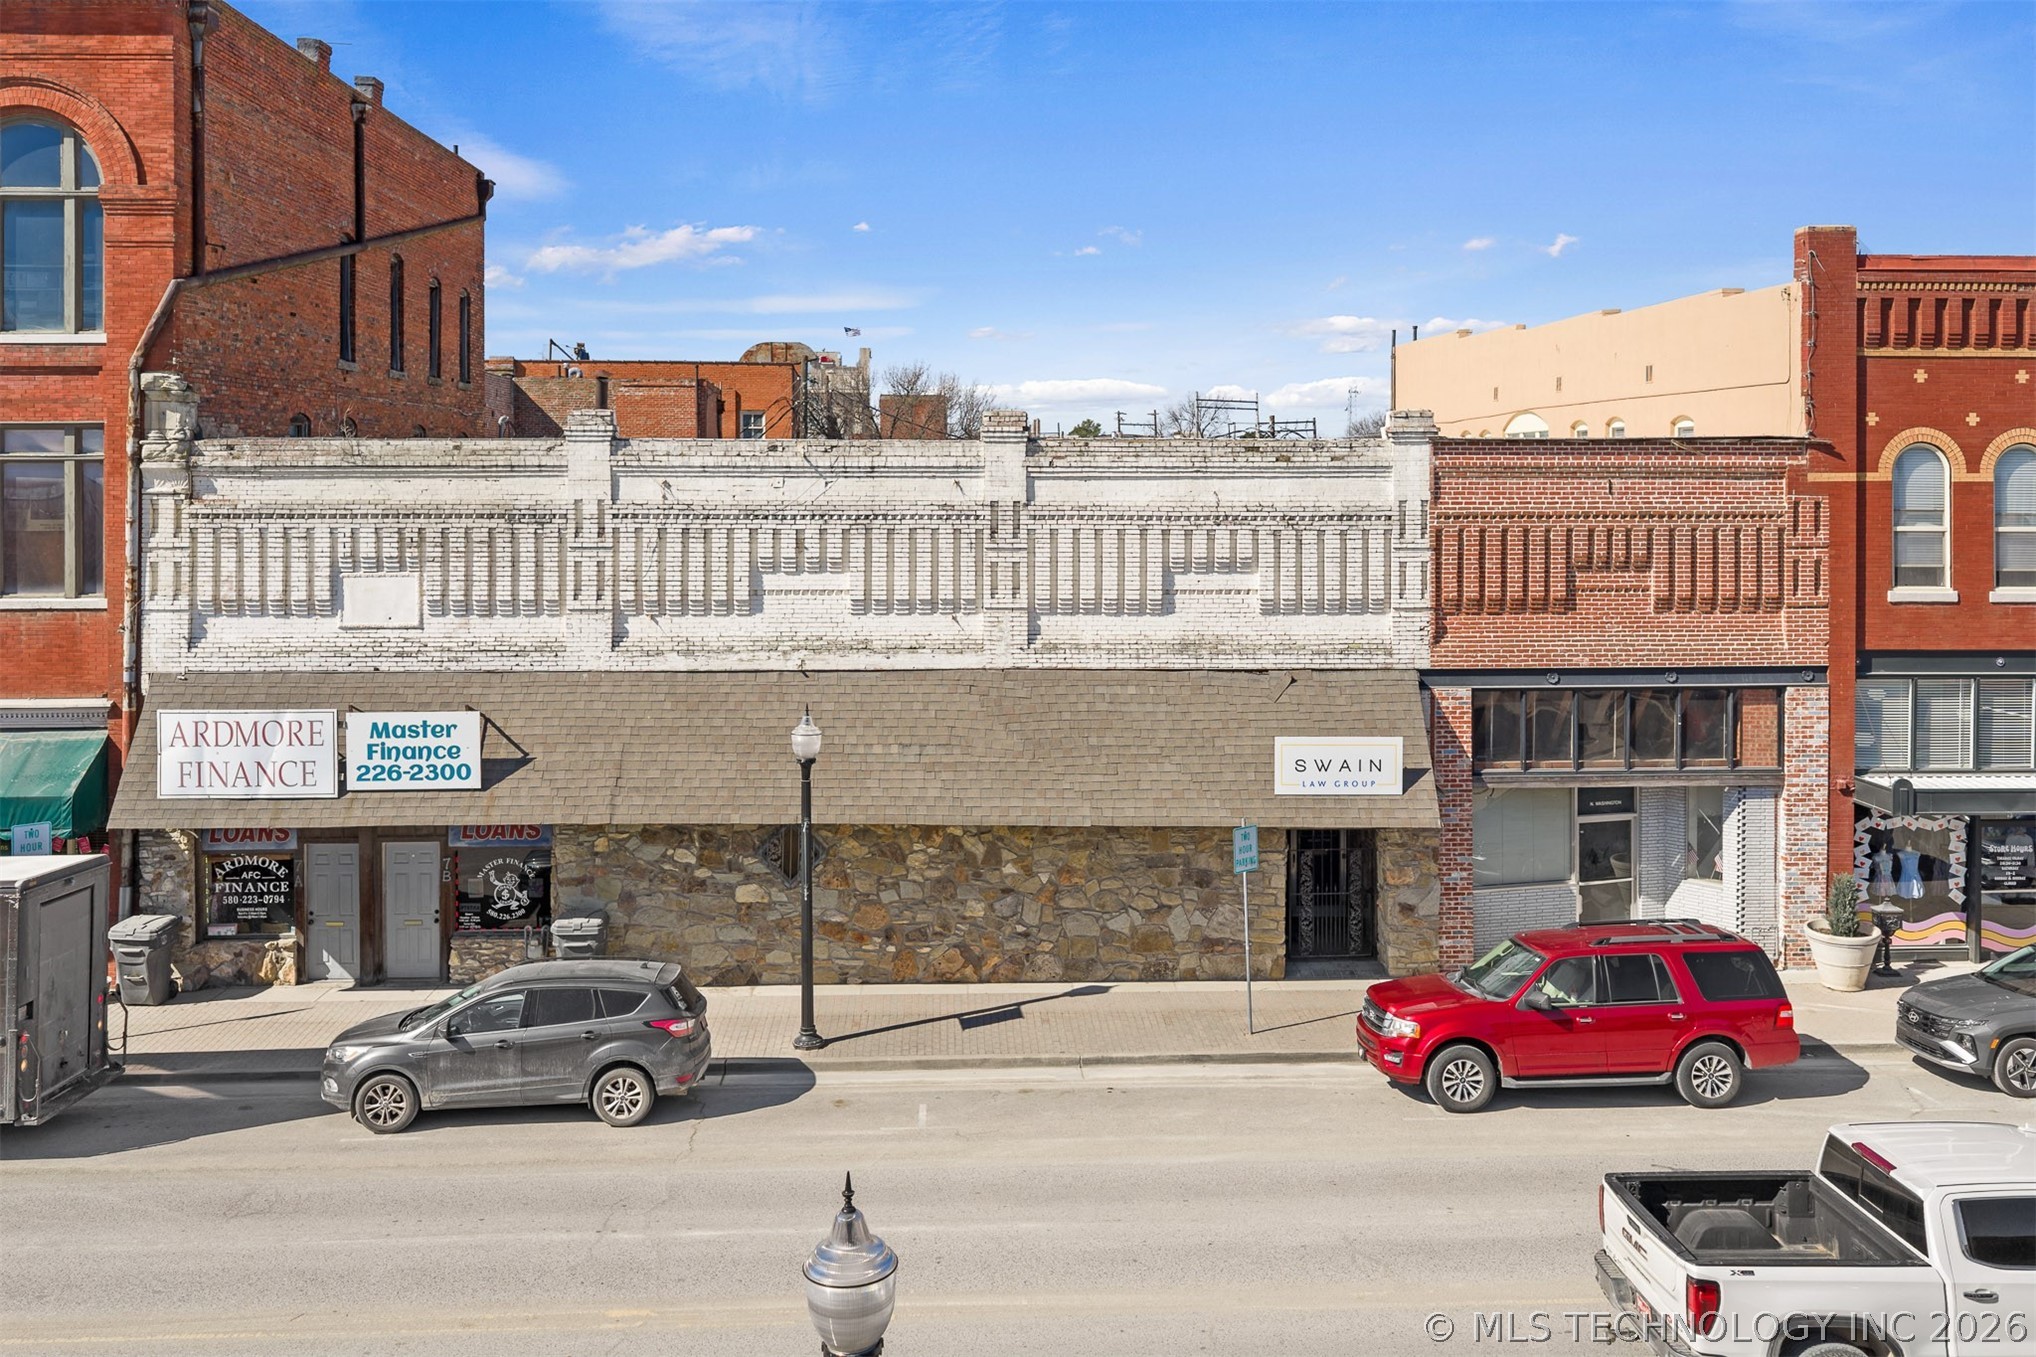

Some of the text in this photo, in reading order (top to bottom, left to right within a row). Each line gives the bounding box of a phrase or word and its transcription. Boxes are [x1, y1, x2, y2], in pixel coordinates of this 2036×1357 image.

[169, 719, 325, 748] ARDMORE
[369, 721, 458, 740] Master
[366, 741, 460, 761] Finance
[356, 762, 471, 783] 226-2300
[1294, 758, 1382, 773] SWAIN
[177, 760, 317, 789] FINANCE
[1302, 780, 1376, 788] LAW GROUP
[24, 829, 40, 839] TWO
[208, 827, 291, 844] LOANS
[461, 824, 542, 840] LOANS
[20, 842, 43, 853] HOUR
[214, 855, 289, 879] ARDMORE
[442, 857, 451, 870] 7
[477, 857, 536, 880] MASTER FINANCE
[241, 871, 261, 880] AFC
[215, 881, 290, 893] FINANCE
